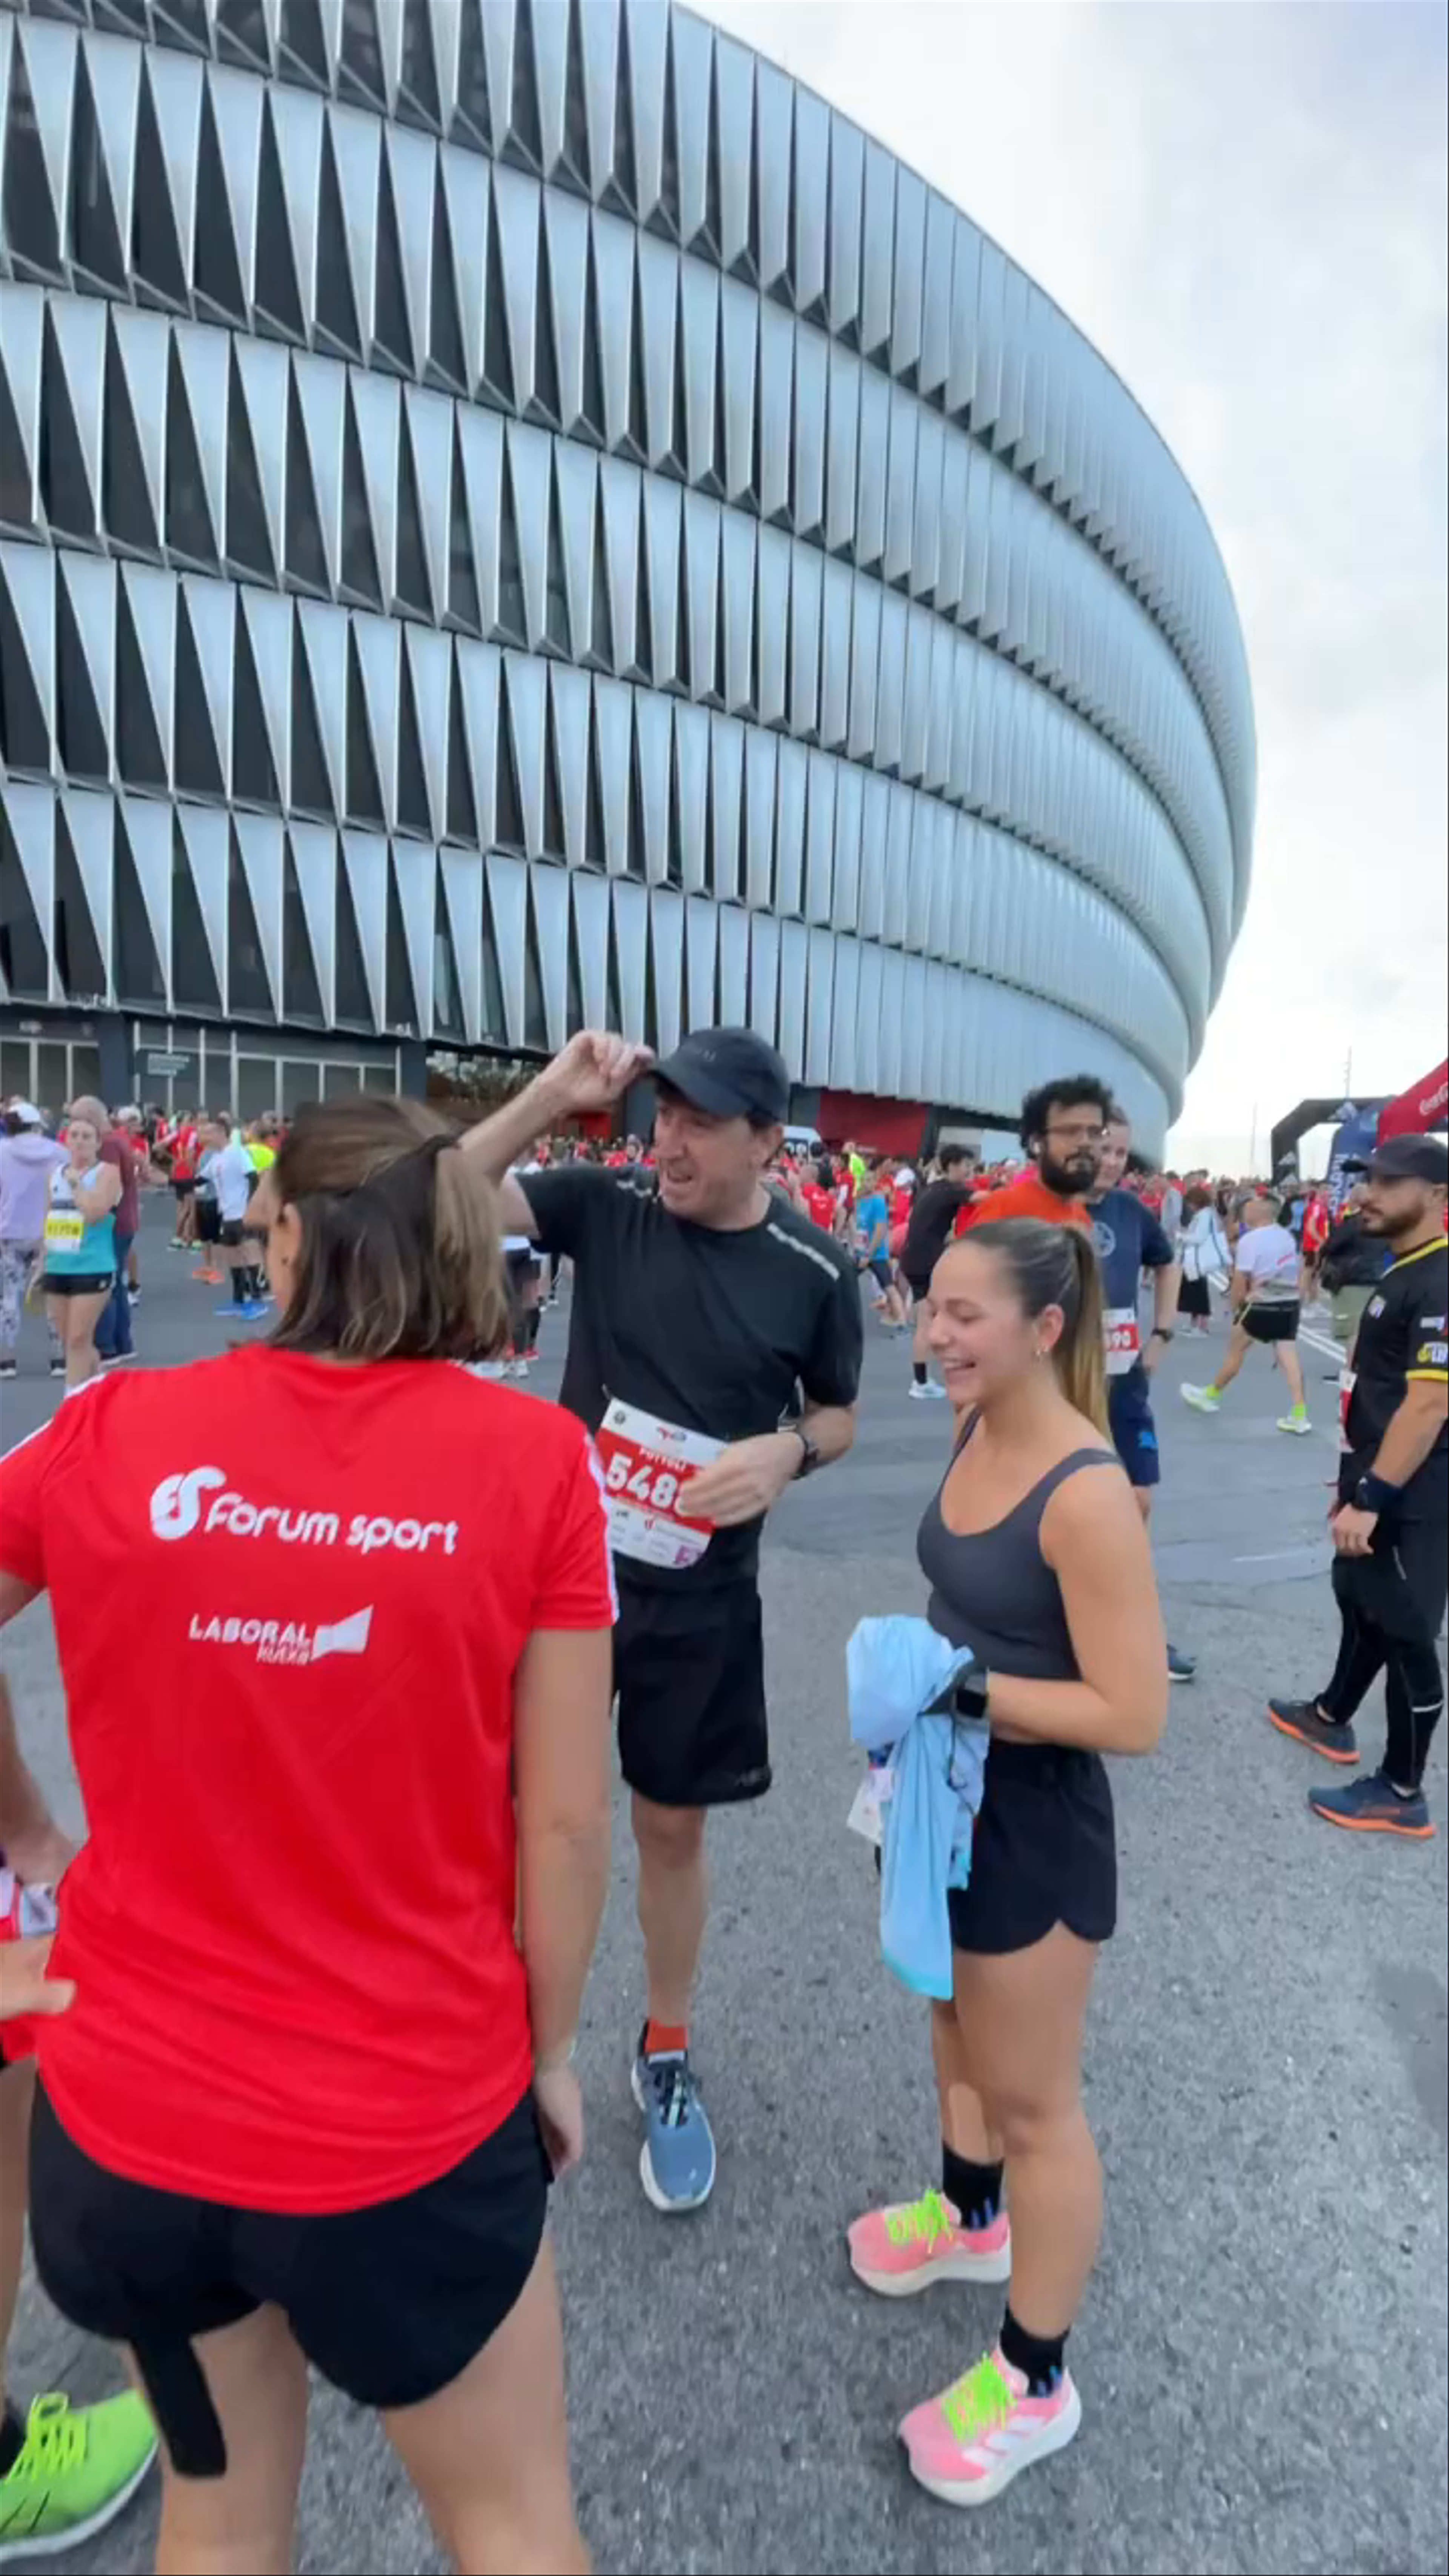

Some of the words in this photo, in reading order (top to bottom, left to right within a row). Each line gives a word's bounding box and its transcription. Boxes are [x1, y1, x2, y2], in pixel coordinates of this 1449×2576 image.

[606, 1452, 681, 1509] 548
[346, 1515, 458, 1555] sport
[188, 1614, 310, 1646] LABORAL
